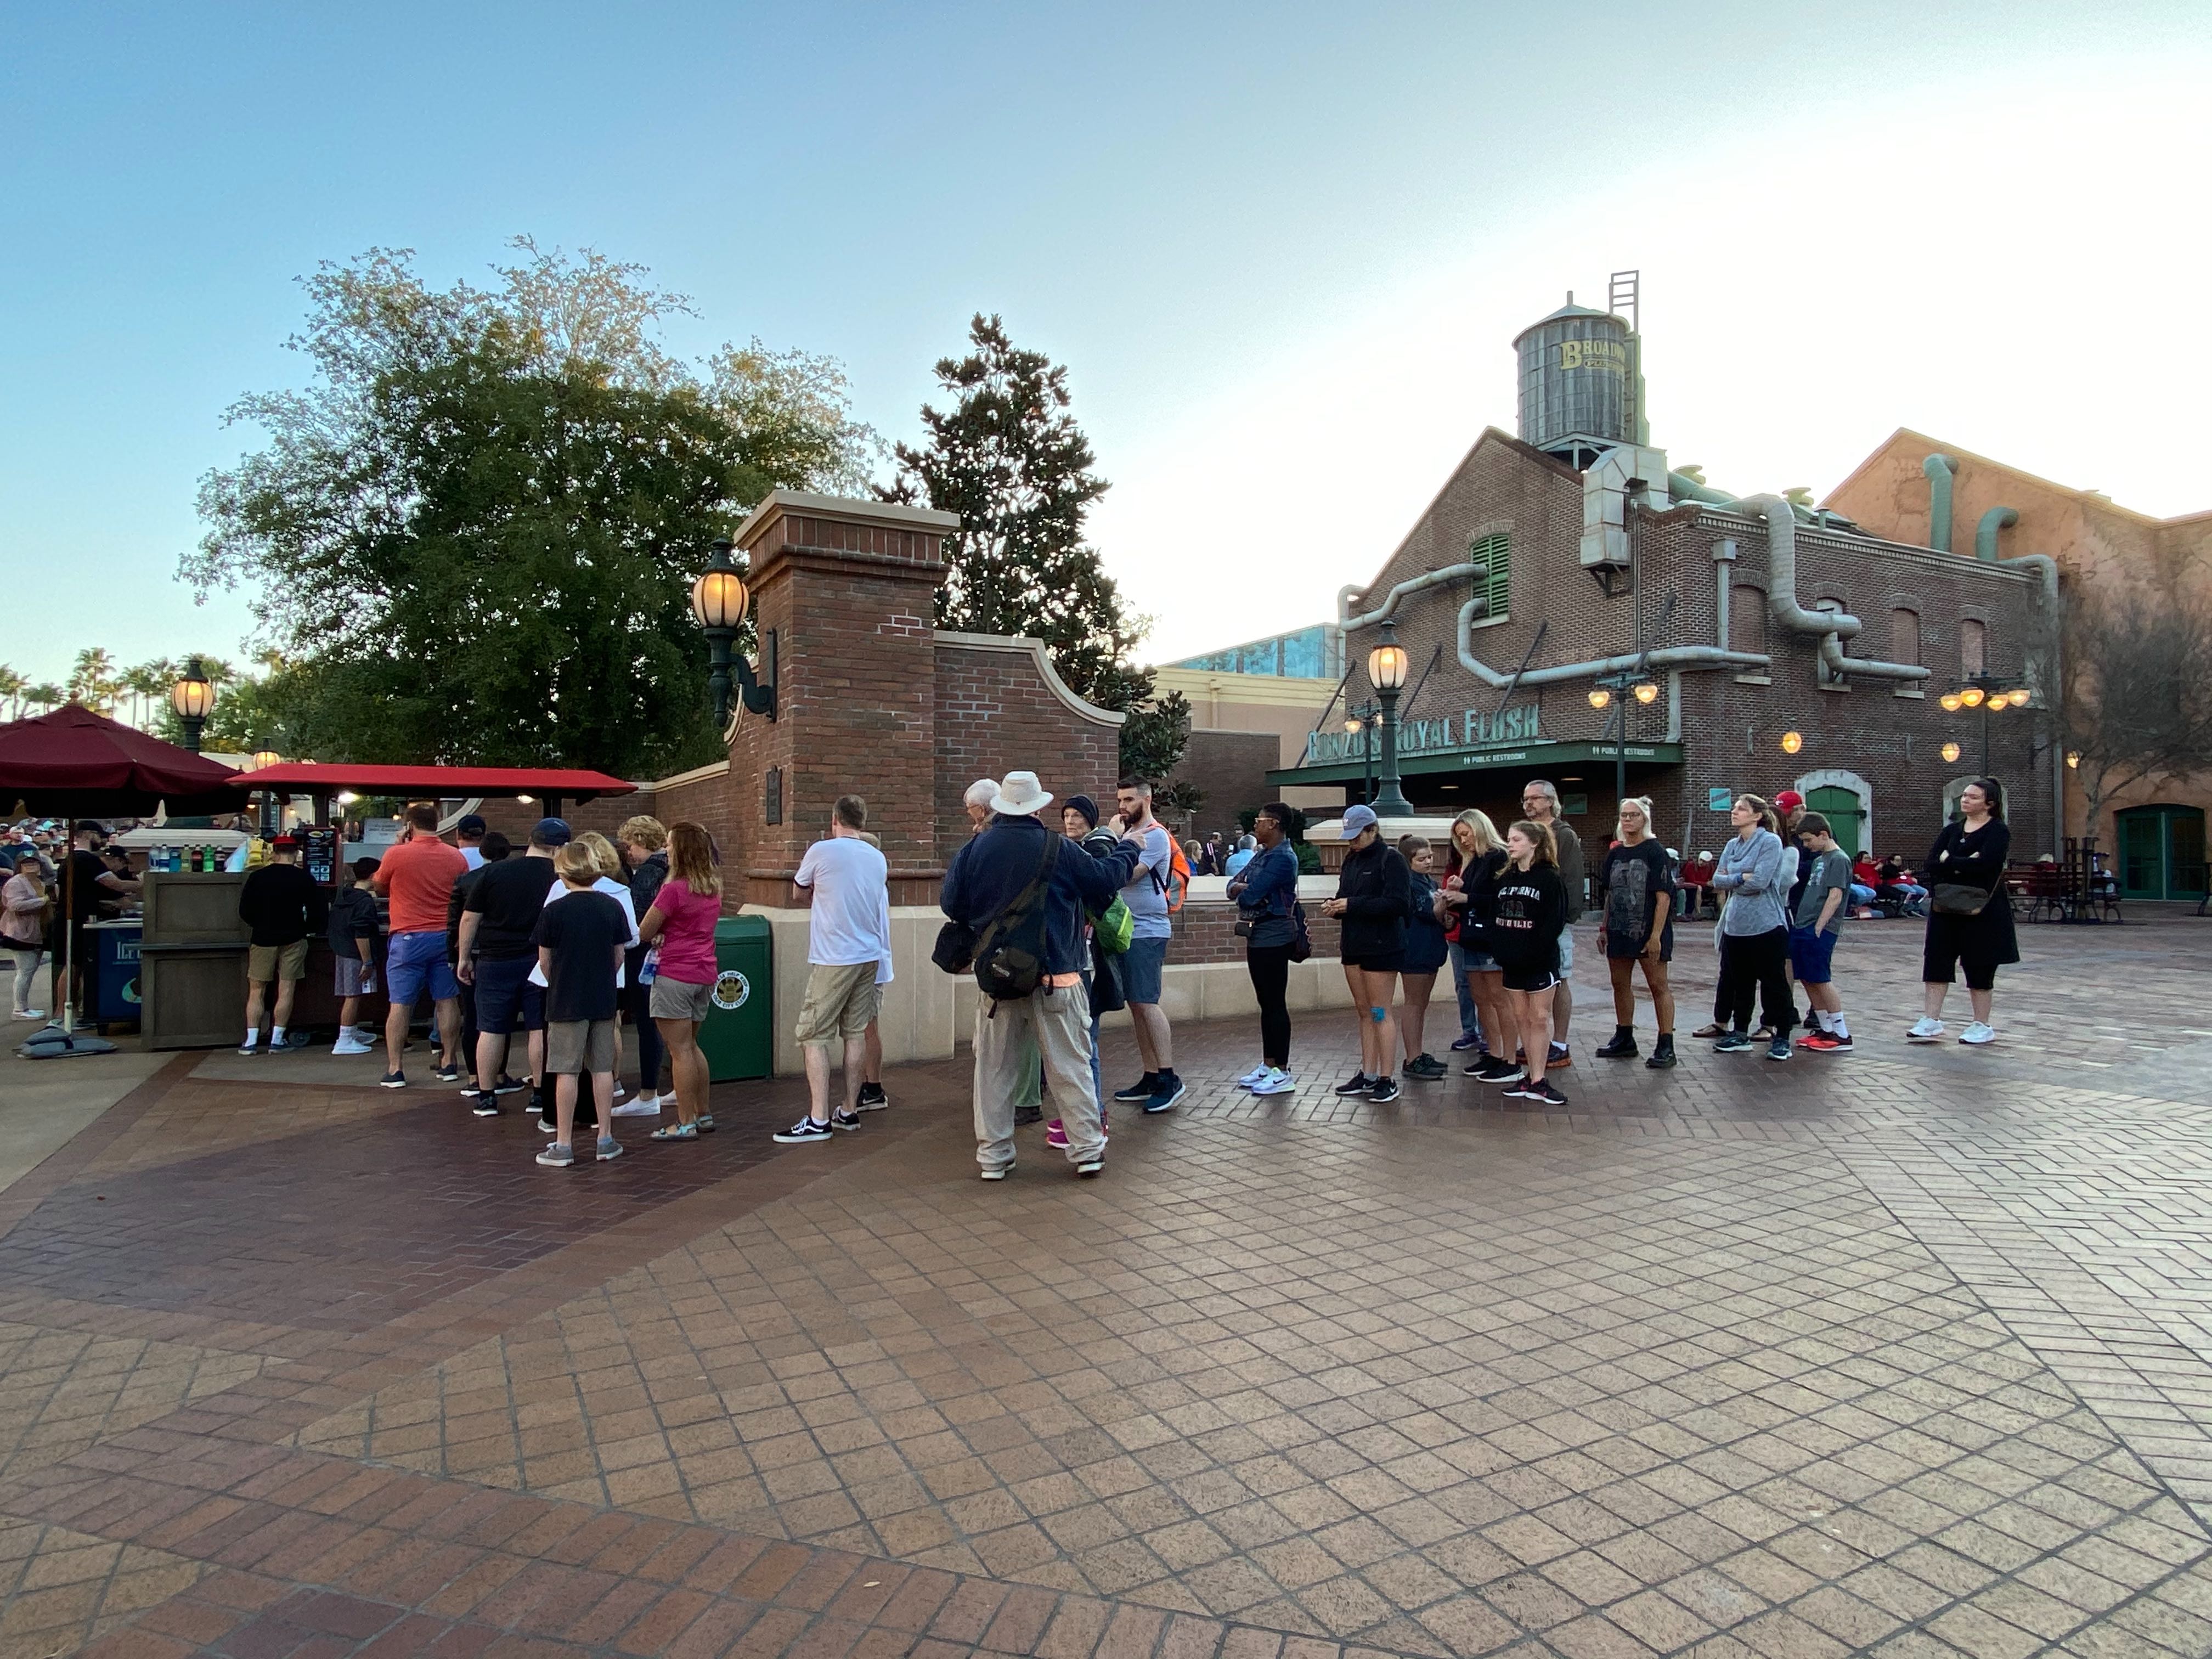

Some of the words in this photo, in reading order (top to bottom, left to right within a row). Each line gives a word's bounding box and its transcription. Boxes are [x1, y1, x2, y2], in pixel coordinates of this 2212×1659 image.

[1308, 725, 1382, 761] GONZOS
[1464, 704, 1538, 744] FLUSH
[1493, 753, 1526, 762] RESTROOMS
